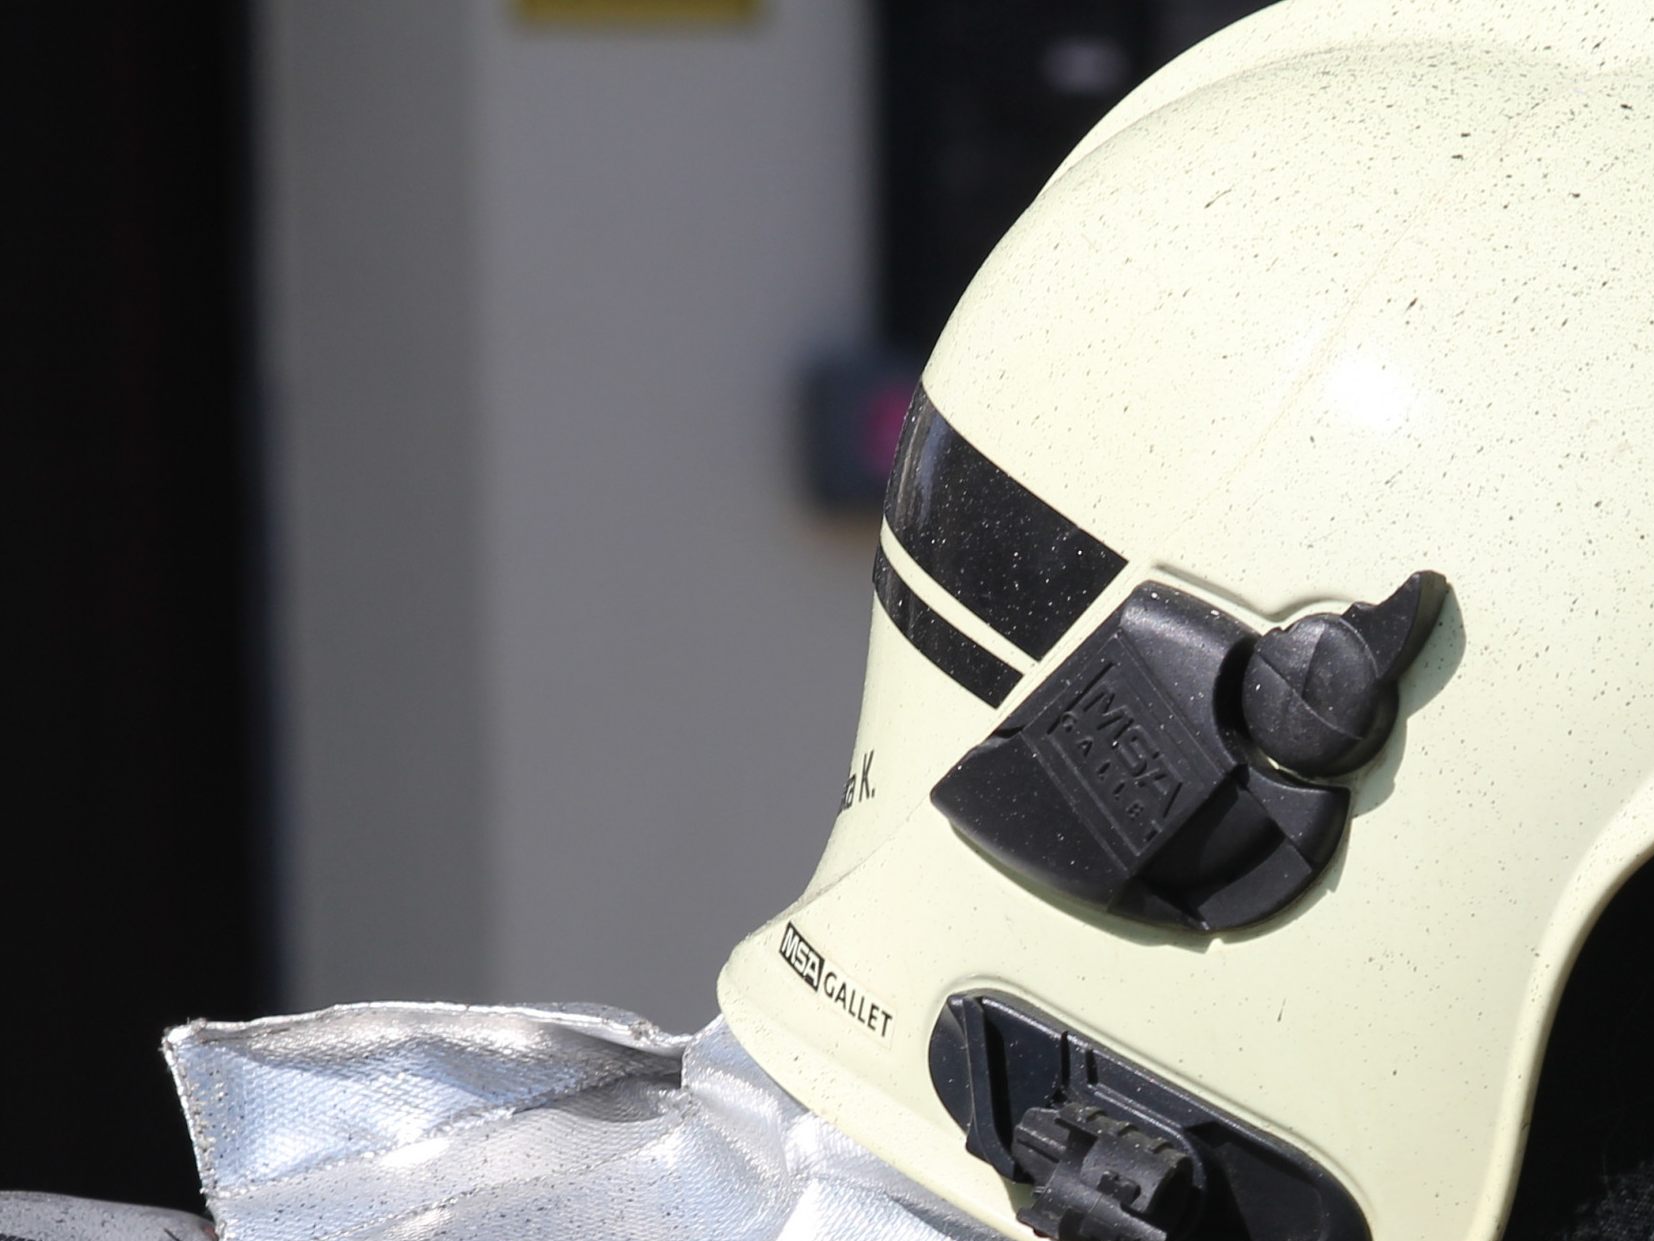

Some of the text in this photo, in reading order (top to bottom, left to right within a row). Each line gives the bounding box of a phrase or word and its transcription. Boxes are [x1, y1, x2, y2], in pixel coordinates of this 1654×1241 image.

[1081, 691, 1184, 820] MSA
[780, 924, 893, 1038] MSA GALLET
